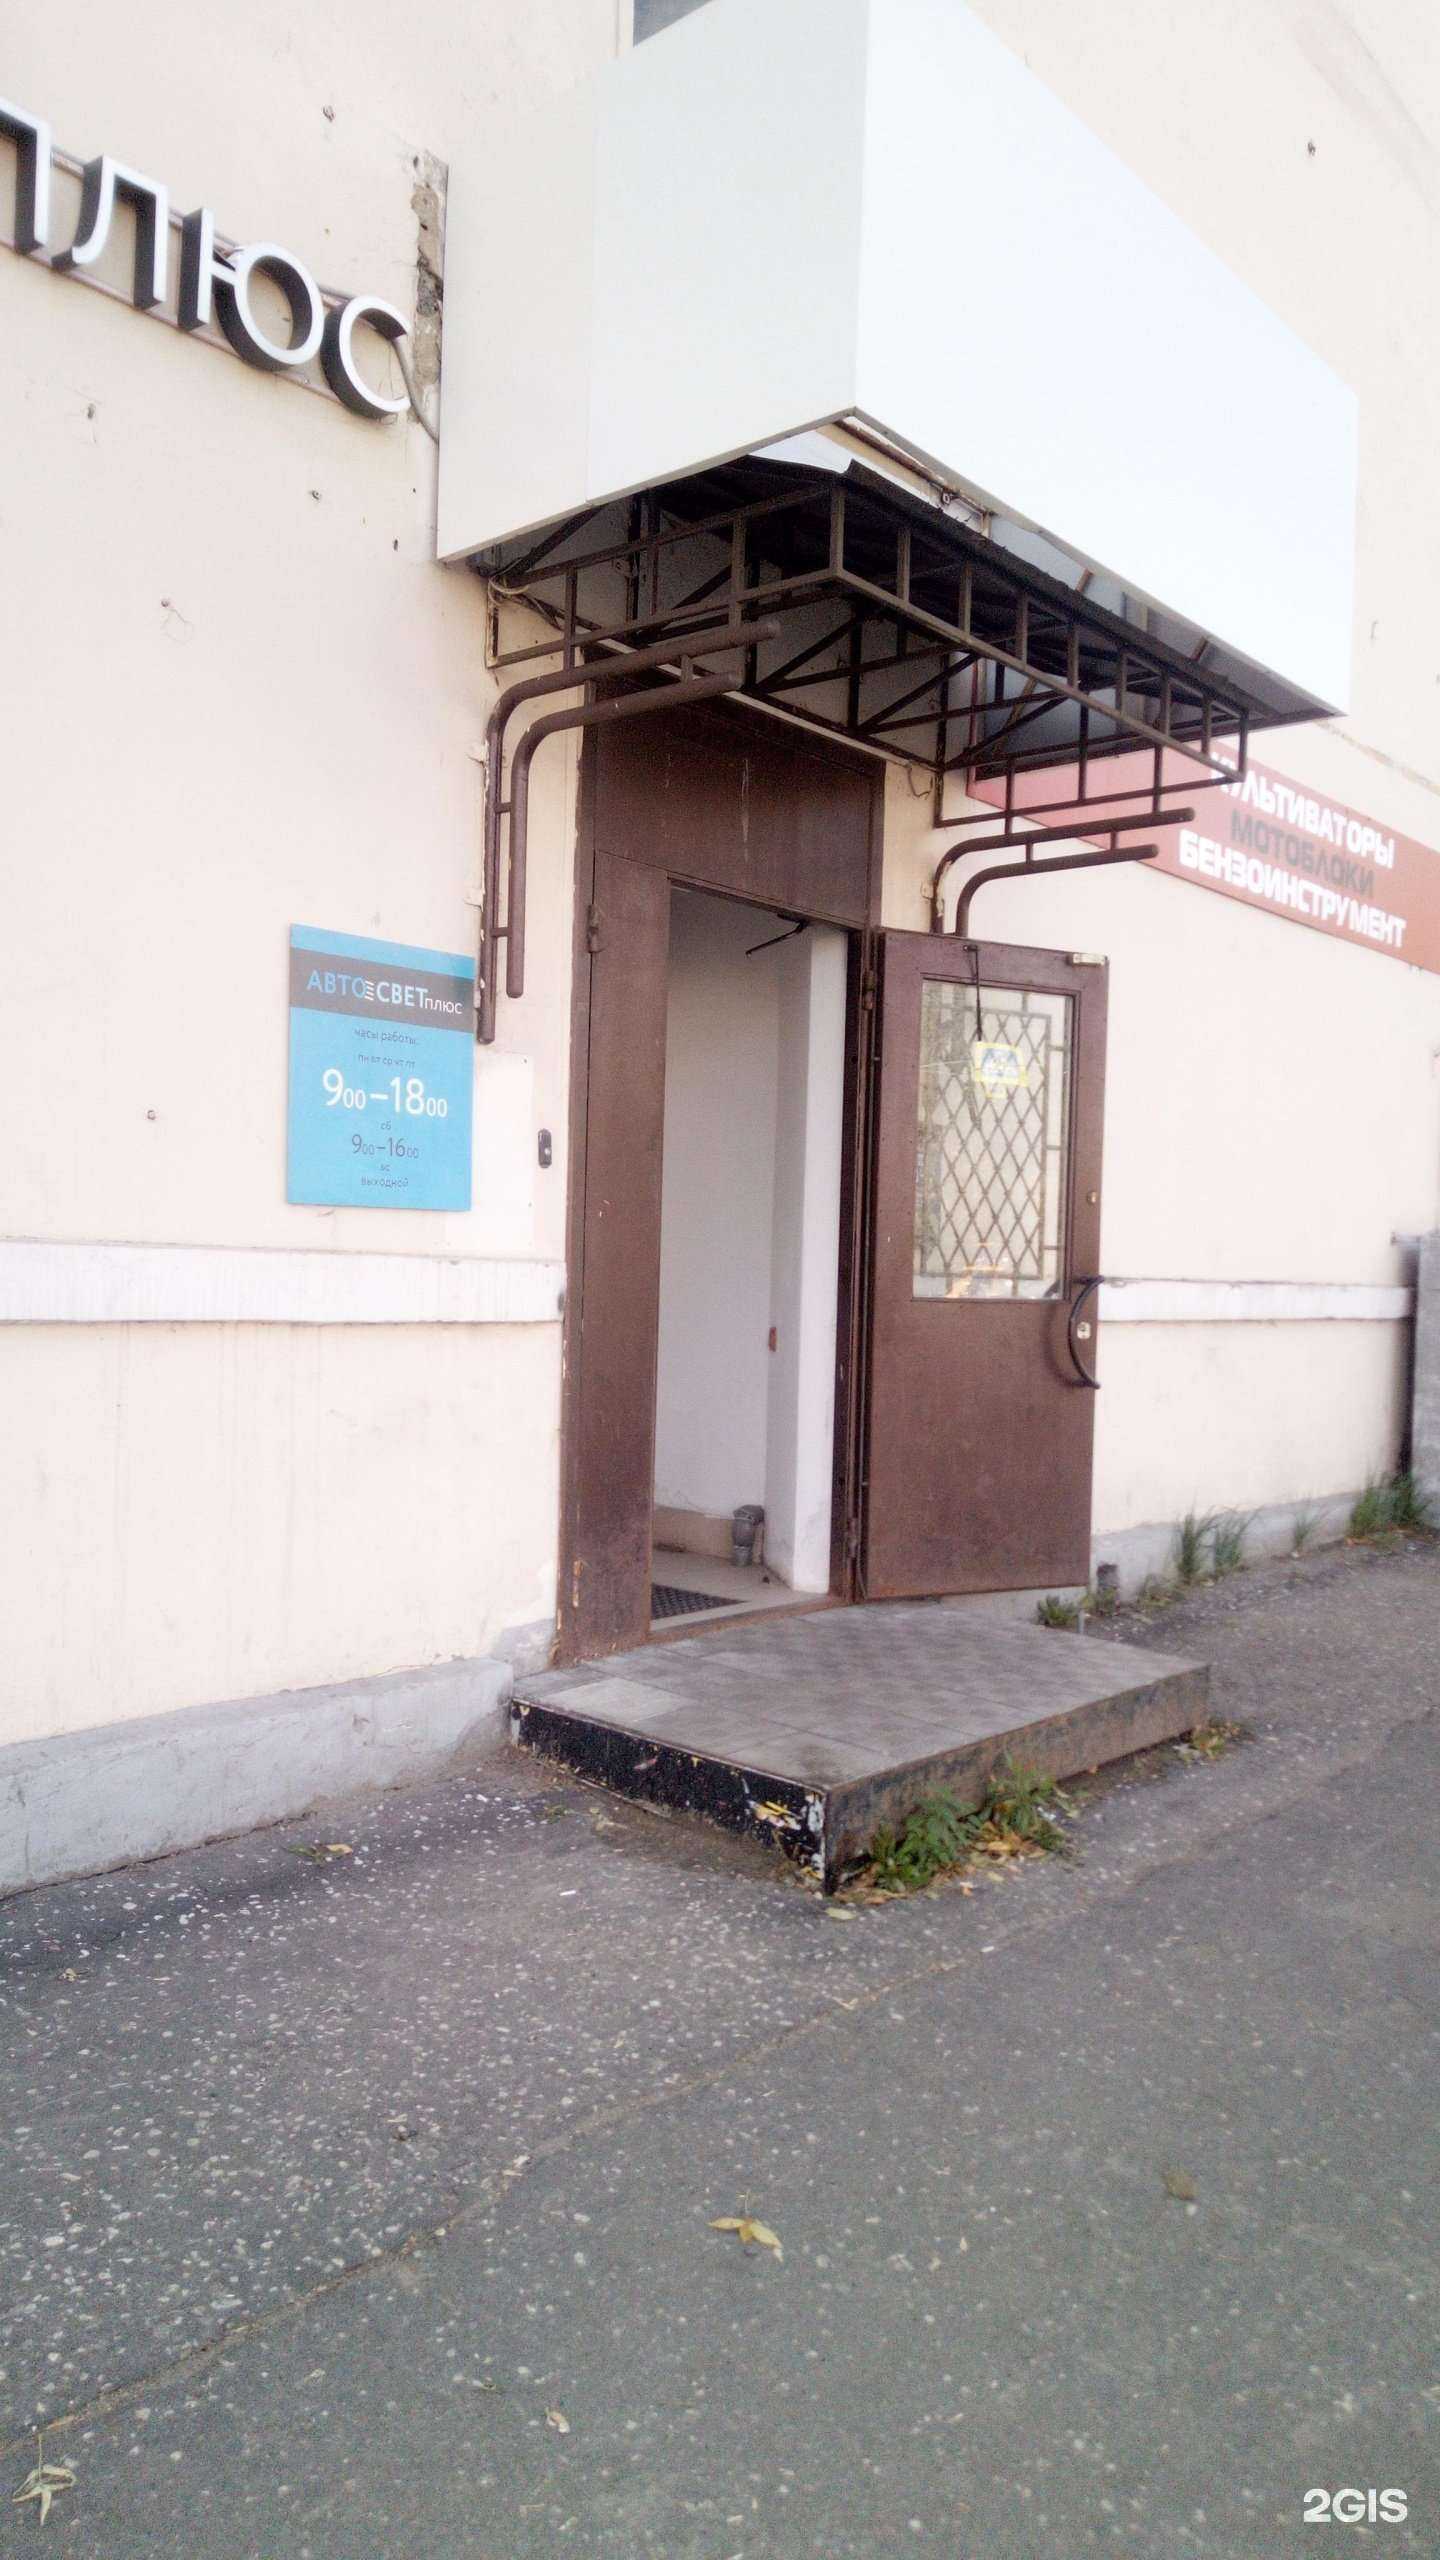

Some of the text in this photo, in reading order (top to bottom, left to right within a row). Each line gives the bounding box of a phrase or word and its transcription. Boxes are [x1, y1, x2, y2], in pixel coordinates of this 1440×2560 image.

[1230, 808, 1375, 898] МОТОБЛОКИ
[1178, 828, 1407, 948] БЕНЗОИНСТРУМЕНТ
[380, 1120, 391, 1130] сб
[360, 1175, 409, 1189] выходной
